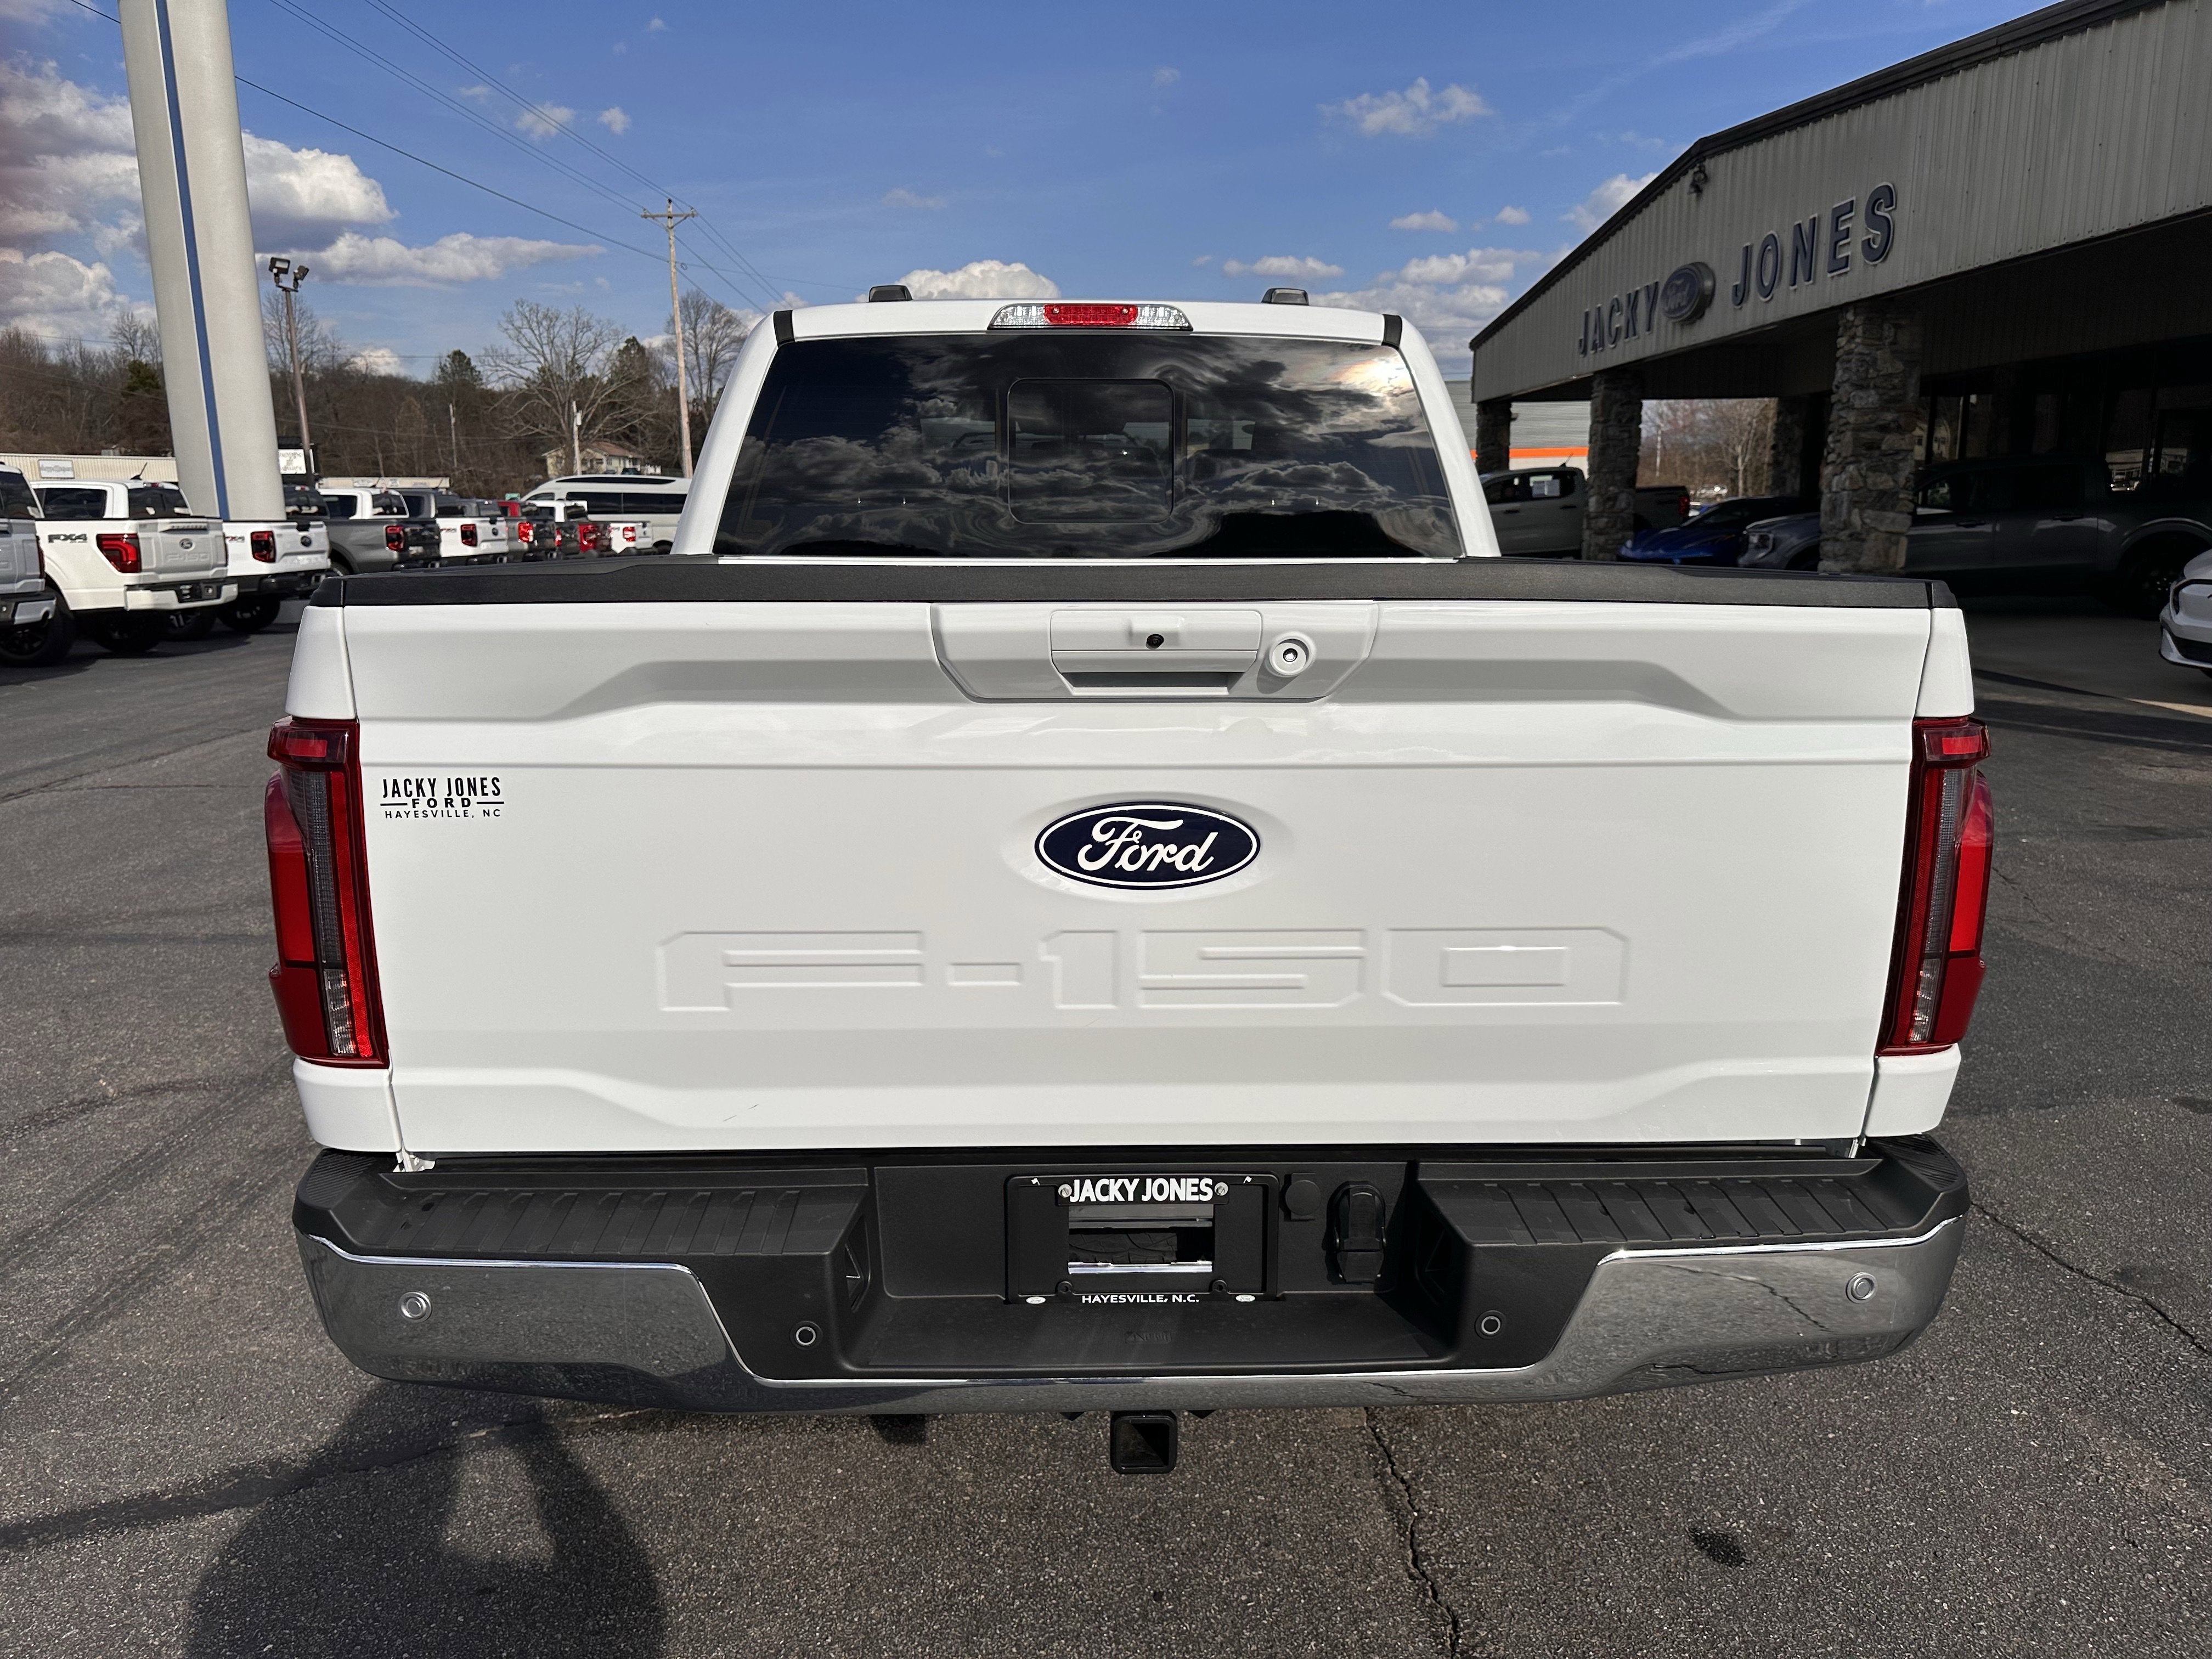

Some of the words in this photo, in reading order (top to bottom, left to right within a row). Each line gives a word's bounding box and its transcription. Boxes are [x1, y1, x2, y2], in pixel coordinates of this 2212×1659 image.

[1578, 281, 1660, 357] JACKY
[1731, 182, 1897, 309] JONES
[48, 533, 88, 543] FX4
[383, 778, 437, 798] JACKY
[447, 777, 501, 797] JONES
[385, 809, 475, 819] HAYESVILLE,
[483, 809, 500, 817] NC
[411, 798, 471, 809] FORD
[1077, 816, 1218, 872] Ford
[655, 927, 1630, 1013] F-150
[1069, 1178, 1140, 1203] JACKY
[1141, 1178, 1214, 1201] JONES
[1082, 1294, 1169, 1304] HAYESVILLE,
[1172, 1294, 1200, 1303] N.C.
